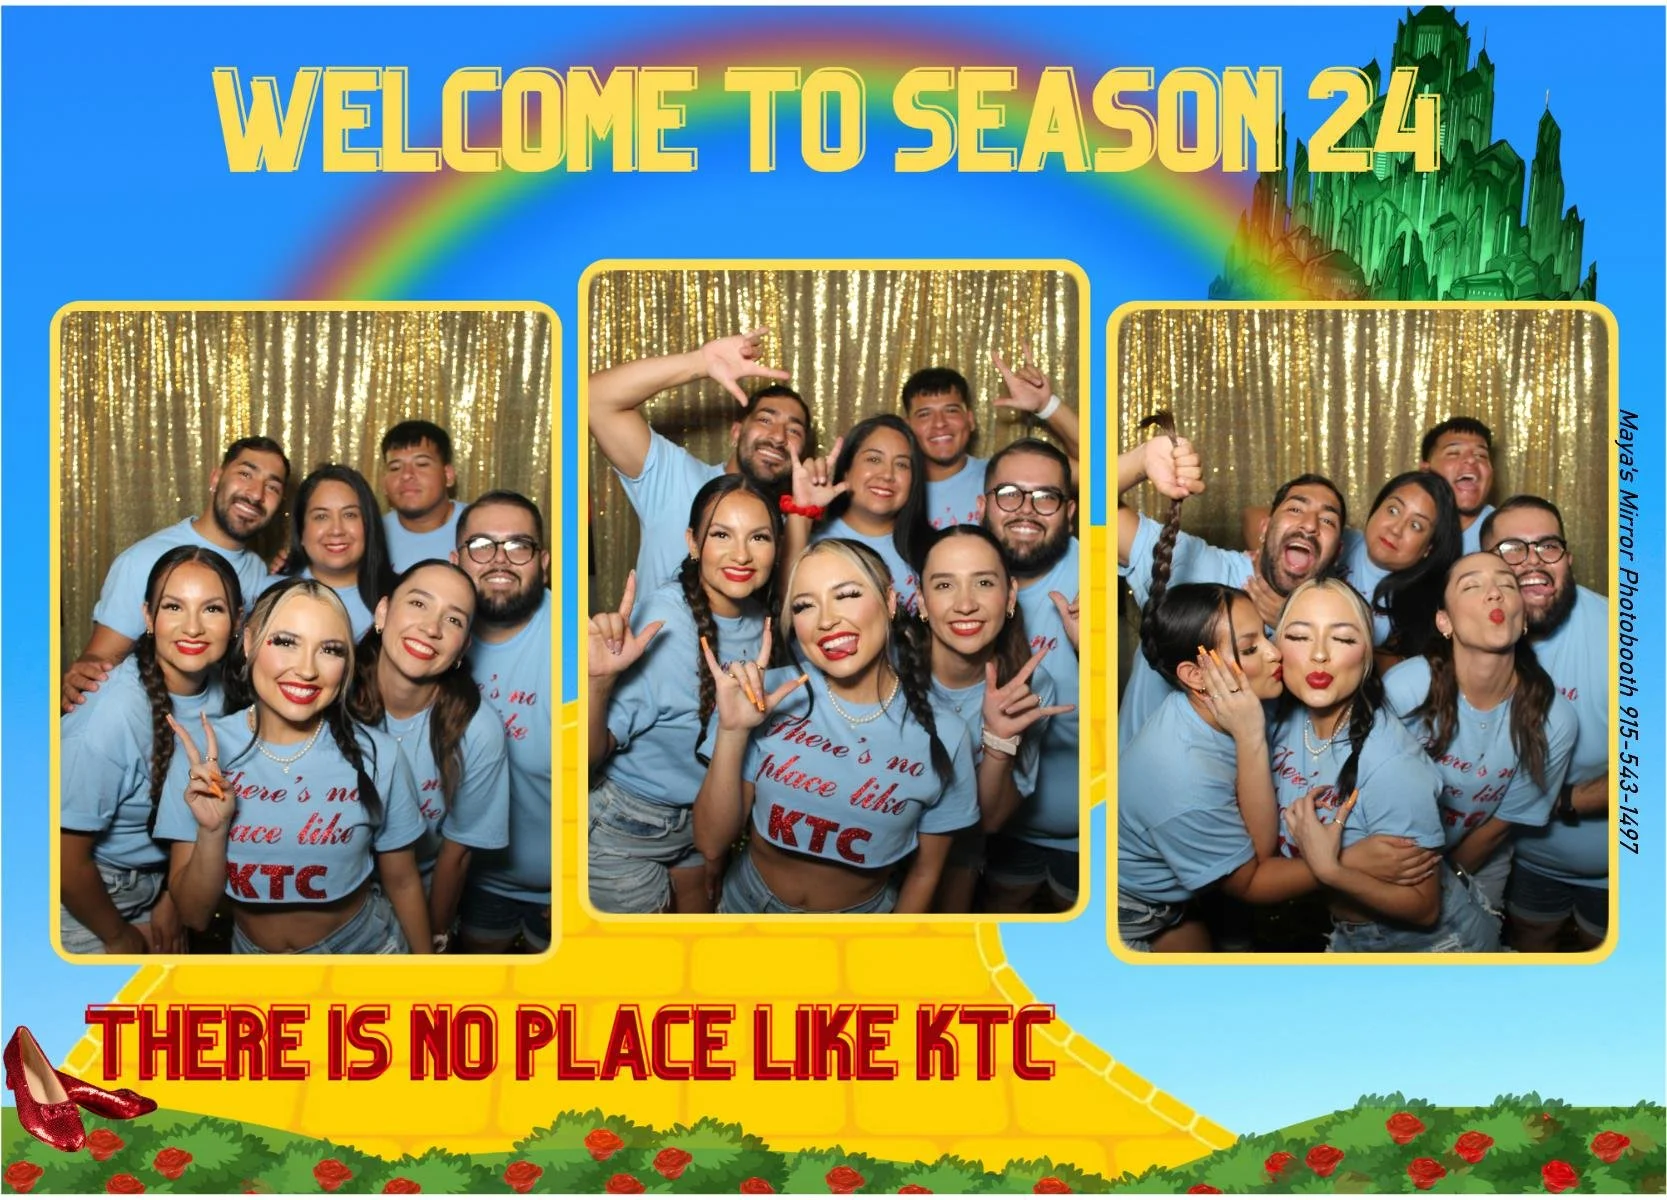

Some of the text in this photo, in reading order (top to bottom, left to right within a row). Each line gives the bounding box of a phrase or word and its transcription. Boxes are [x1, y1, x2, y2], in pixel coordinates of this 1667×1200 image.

[508, 690, 537, 706] no
[503, 712, 529, 741] ke
[765, 715, 926, 778] There's no
[755, 753, 908, 816] place like
[228, 809, 355, 846] ace like
[767, 803, 874, 864] KTC
[225, 860, 329, 900] KTC
